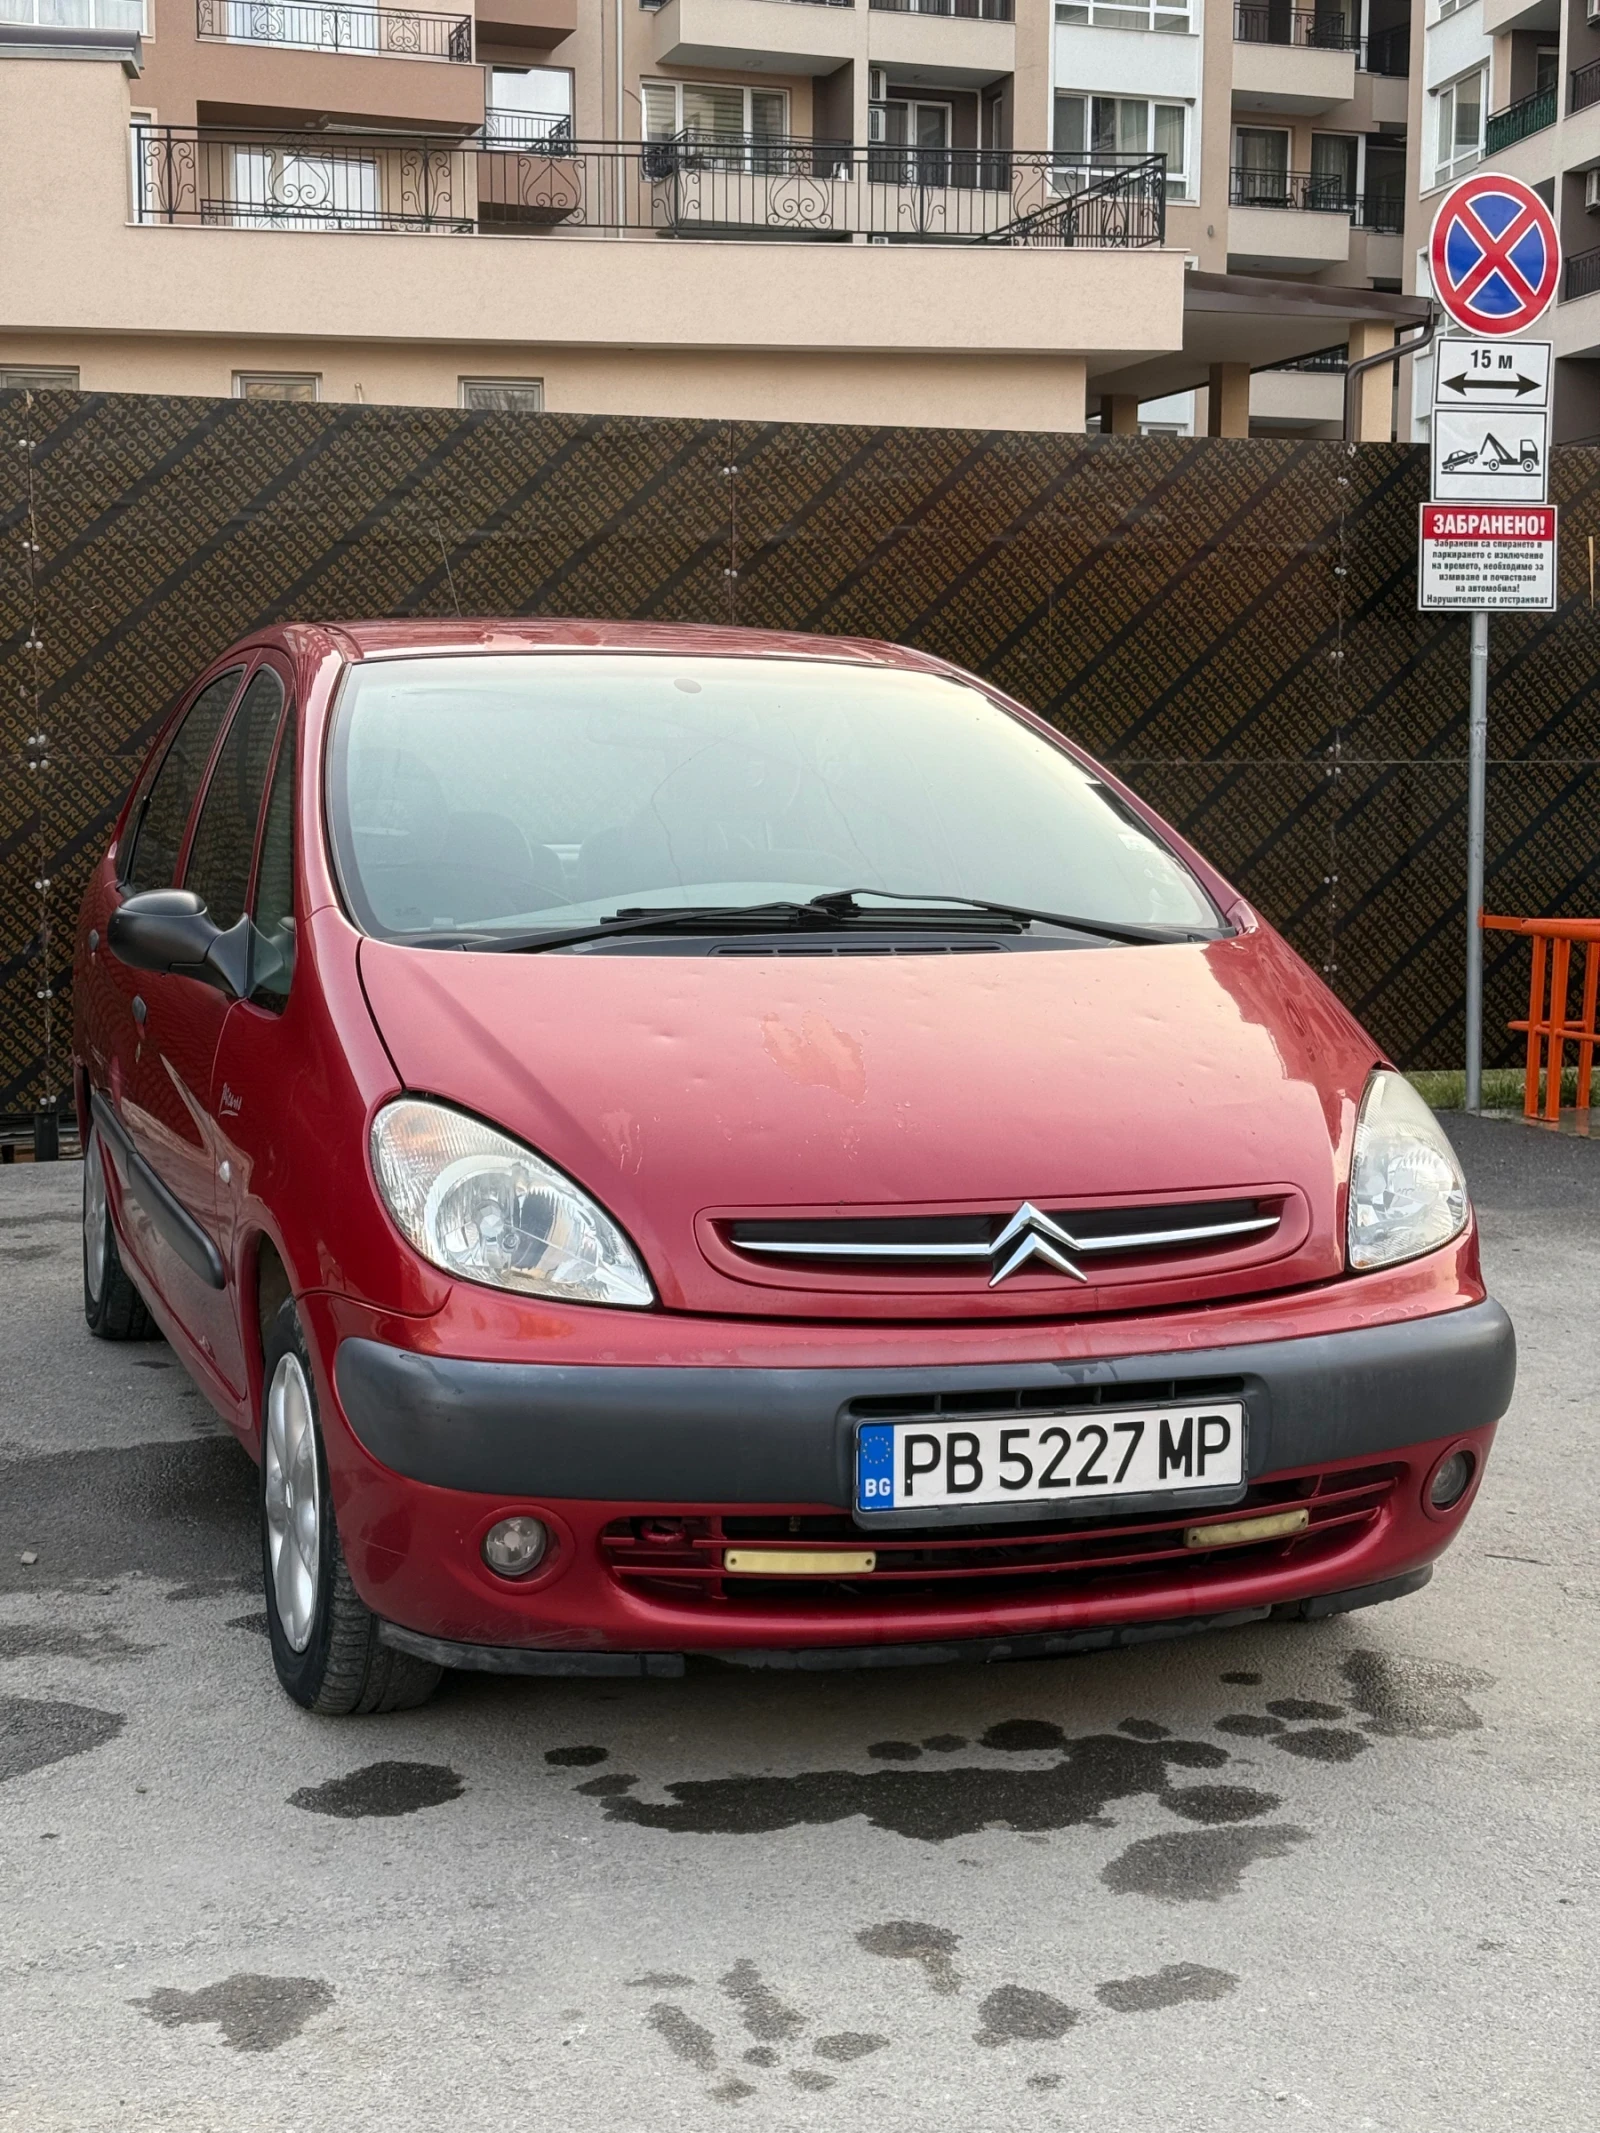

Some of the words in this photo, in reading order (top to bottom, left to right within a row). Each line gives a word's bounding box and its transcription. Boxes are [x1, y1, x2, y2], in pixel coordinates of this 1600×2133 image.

[1470, 349, 1491, 369] 15
[95, 407, 156, 471] SKYFORM
[236, 404, 293, 466] SKYFORM
[340, 430, 397, 492] SKYFORM
[361, 412, 417, 471] SKYFORM
[483, 417, 539, 476] SKYFORM
[602, 423, 654, 480] SKYFORM
[40, 458, 101, 522] SKYFORM
[63, 439, 122, 500] SKYFORM
[182, 455, 241, 516] SKYFORM
[204, 434, 261, 496] SKYFORM
[319, 450, 376, 512] SKYFORM
[463, 436, 518, 495] SKYFORM
[561, 460, 615, 520] SKYFORM
[581, 441, 635, 501] SKYFORM
[761, 445, 813, 502] SKYFORM
[884, 438, 932, 496] SKYFORM
[975, 461, 1021, 517] SKYFORM
[994, 442, 1040, 498] SKYFORM
[1091, 454, 1137, 510] SKYFORM
[1110, 437, 1156, 491] SKYFORM
[1205, 448, 1249, 501] SKYFORM
[160, 475, 219, 536] SKYFORM
[298, 470, 355, 532] SKYFORM
[432, 466, 486, 525] SKYFORM
[532, 491, 583, 548] SKYFORM
[678, 466, 729, 523] SKYFORM
[742, 464, 793, 521] SKYFORM
[855, 468, 904, 523] SKYFORM
[947, 490, 993, 546] SKYFORM
[1073, 473, 1119, 529] SKYFORM
[1178, 476, 1222, 529] SKYFORM
[1271, 489, 1315, 541] SKYFORM
[1289, 469, 1333, 522] SKYFORM
[127, 505, 186, 566] SKYFORM
[256, 511, 312, 570] SKYFORM
[277, 492, 333, 551] SKYFORM
[391, 505, 446, 564] SKYFORM
[511, 511, 563, 568] SKYFORM
[629, 516, 679, 570] SKYFORM
[648, 495, 699, 552] SKYFORM
[807, 516, 856, 571] SKYFORM
[826, 497, 875, 552] SKYFORM
[928, 509, 974, 565] SKYFORM
[1045, 503, 1091, 557] SKYFORM
[1141, 514, 1187, 568] SKYFORM
[1160, 495, 1204, 548] SKYFORM
[1254, 507, 1296, 558] SKYFORM
[1433, 514, 1545, 535] ЗАБРАНЕНО!
[1434, 539, 1478, 549] Забранени
[1493, 541, 1535, 550] спирането
[84, 545, 143, 606] SKYFORM
[106, 525, 165, 586] SKYFORM
[224, 541, 280, 600] SKYFORM
[348, 545, 404, 604] SKYFORM
[369, 525, 425, 584] SKYFORM
[470, 548, 524, 607] SKYFORM
[598, 543, 650, 600] SKYFORM
[768, 554, 817, 609] SKYFORM
[787, 535, 836, 590] SKYFORM
[890, 546, 936, 602] SKYFORM
[909, 527, 955, 583] SKYFORM
[998, 548, 1044, 604] SKYFORM
[1017, 529, 1063, 585] SKYFORM
[1123, 532, 1167, 585] SKYFORM
[1226, 533, 1270, 586] SKYFORM
[1347, 529, 1391, 581] SKYFORM
[1432, 551, 1485, 560] паркирането
[1444, 563, 1481, 571] времето,
[1483, 561, 1532, 571] необходимо
[202, 559, 259, 621] SKYFORM
[578, 562, 629, 619] SKYFORM
[748, 574, 798, 628] SKYFORM
[861, 575, 907, 631] SKYFORM
[979, 567, 1025, 623] SKYFORM
[1095, 561, 1141, 615] SKYFORM
[1181, 580, 1225, 633] SKYFORM
[1199, 561, 1243, 614] SKYFORM
[1292, 573, 1334, 624] SKYFORM
[1427, 594, 1485, 605] Нарушителите
[1499, 596, 1548, 605] отстраняват
[1468, 583, 1520, 593] автомобила!
[40, 586, 99, 647] SKYFORM
[147, 610, 206, 671] SKYFORM
[170, 589, 227, 651] SKYFORM
[932, 615, 978, 671] SKYFORM
[951, 596, 997, 652] SKYFORM
[1067, 589, 1113, 643] SKYFORM
[1154, 608, 1198, 661] SKYFORM
[1265, 601, 1309, 653] SKYFORM
[1367, 612, 1409, 663] SKYFORM
[1385, 594, 1427, 645] SKYFORM
[126, 630, 185, 691] SKYFORM
[1020, 636, 1067, 689] SKYFORM
[1040, 617, 1084, 670] SKYFORM
[1126, 636, 1170, 689] SKYFORM
[1238, 629, 1282, 681] SKYFORM
[1348, 631, 1392, 683] SKYFORM
[1538, 644, 1580, 694] SKYFORM
[93, 661, 152, 722] SKYFORM
[1002, 654, 1048, 710] SKYFORM
[1089, 675, 1135, 729] SKYFORM
[1108, 655, 1152, 708] SKYFORM
[1211, 657, 1255, 709] SKYFORM
[1413, 668, 1455, 719] SKYFORM
[1502, 680, 1543, 729] SKYFORM
[1520, 662, 1562, 712] SKYFORM
[60, 692, 119, 753] SKYFORM
[1071, 693, 1115, 746] SKYFORM
[1166, 704, 1210, 756] SKYFORM
[1184, 685, 1228, 737] SKYFORM
[1268, 703, 1312, 755] SKYFORM
[1286, 684, 1328, 735] SKYFORM
[1386, 697, 1428, 746] SKYFORM
[1144, 769, 1188, 821] SKYFORM
[1246, 768, 1288, 819] SKYFORM
[1382, 786, 1424, 837] SKYFORM
[1408, 760, 1450, 810] SKYFORM
[1506, 760, 1548, 810] SKYFORM
[1201, 814, 1243, 865] SKYFORM
[1219, 796, 1261, 847] SKYFORM
[1292, 823, 1334, 874] SKYFORM
[1364, 804, 1406, 855] SKYFORM
[1542, 823, 1584, 872] SKYFORM
[1266, 852, 1308, 902] SKYFORM
[1338, 833, 1380, 882] SKYFORM
[1410, 859, 1451, 908] SKYFORM
[1507, 858, 1548, 907] SKYFORM
[1248, 870, 1290, 920] SKYFORM
[1374, 896, 1417, 946] SKYFORM
[1392, 878, 1435, 928] SKYFORM
[1340, 932, 1382, 982] SKYFORM
[1412, 958, 1454, 1008] SKYFORM
[1377, 994, 1418, 1043] SKYFORM
[904, 1432, 983, 1497] PB
[1000, 1421, 1145, 1490] 5227
[1158, 1415, 1231, 1480] MP
[865, 1478, 891, 1498] BG
